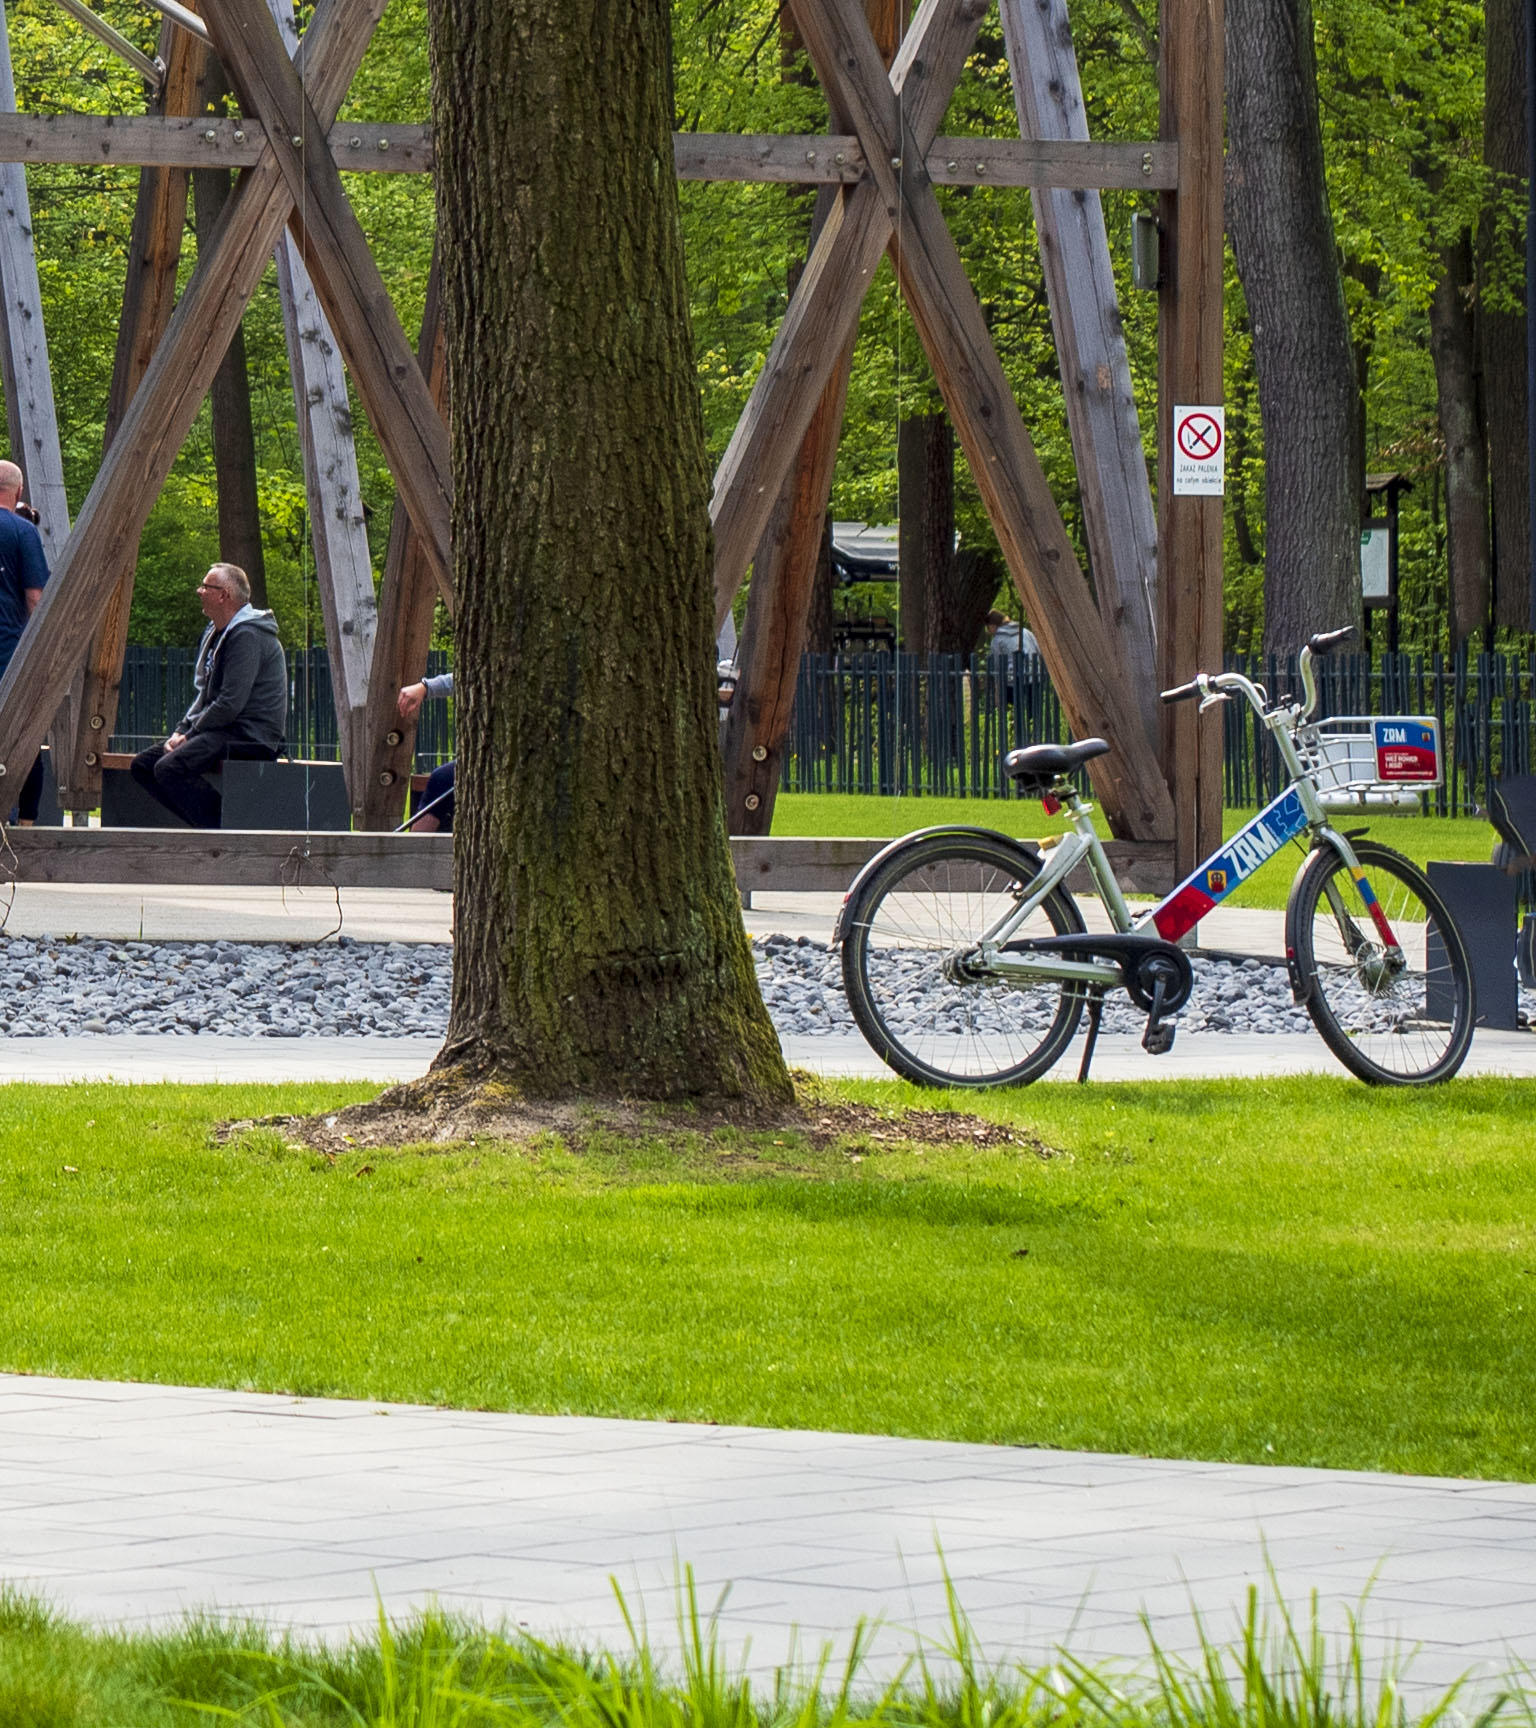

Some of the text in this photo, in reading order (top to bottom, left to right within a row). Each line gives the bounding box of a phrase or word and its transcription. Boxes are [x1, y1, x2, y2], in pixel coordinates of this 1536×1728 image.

[1180, 464, 1218, 472] ZAKAZ PALENIA
[1382, 728, 1406, 743] ZRM
[1222, 821, 1280, 880] ZRM
